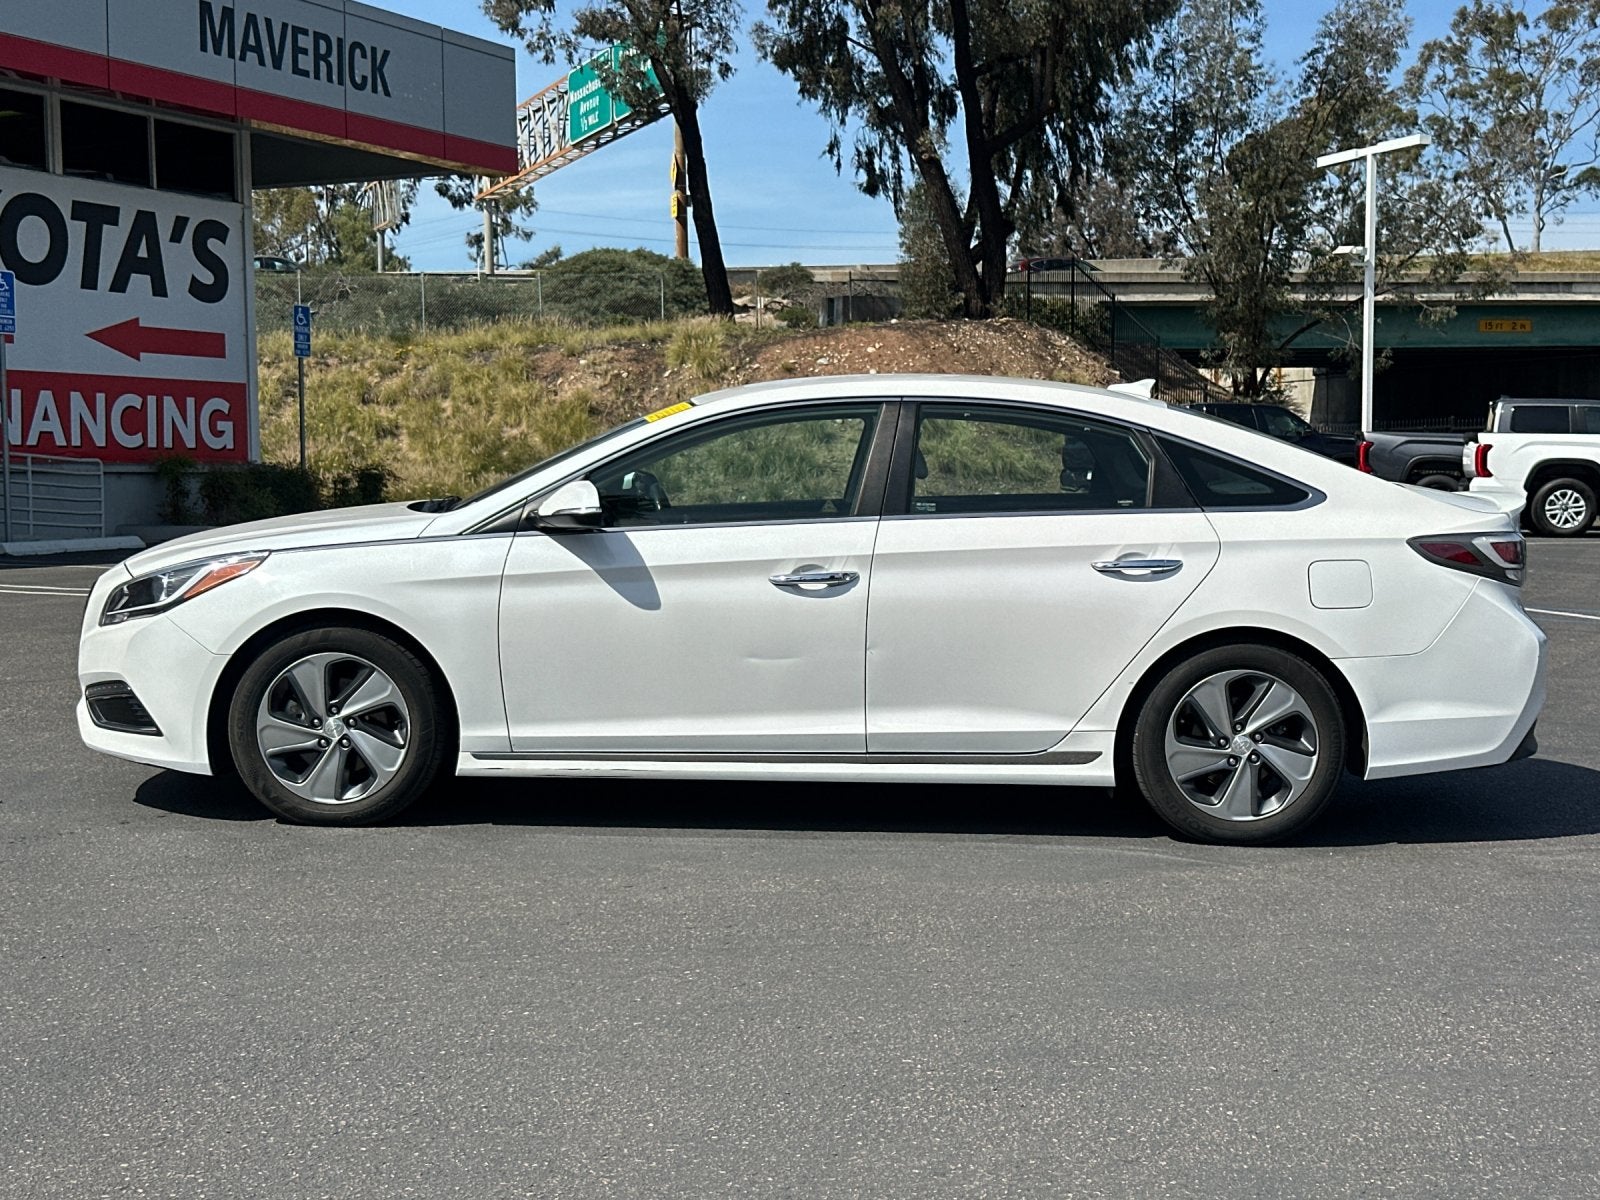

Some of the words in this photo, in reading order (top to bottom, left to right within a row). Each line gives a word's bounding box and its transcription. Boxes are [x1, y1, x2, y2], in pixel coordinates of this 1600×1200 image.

[199, 0, 392, 98] MAVERICK
[580, 95, 600, 116] Avenue
[1484, 321, 1493, 330] 15
[1512, 321, 1517, 330] 2
